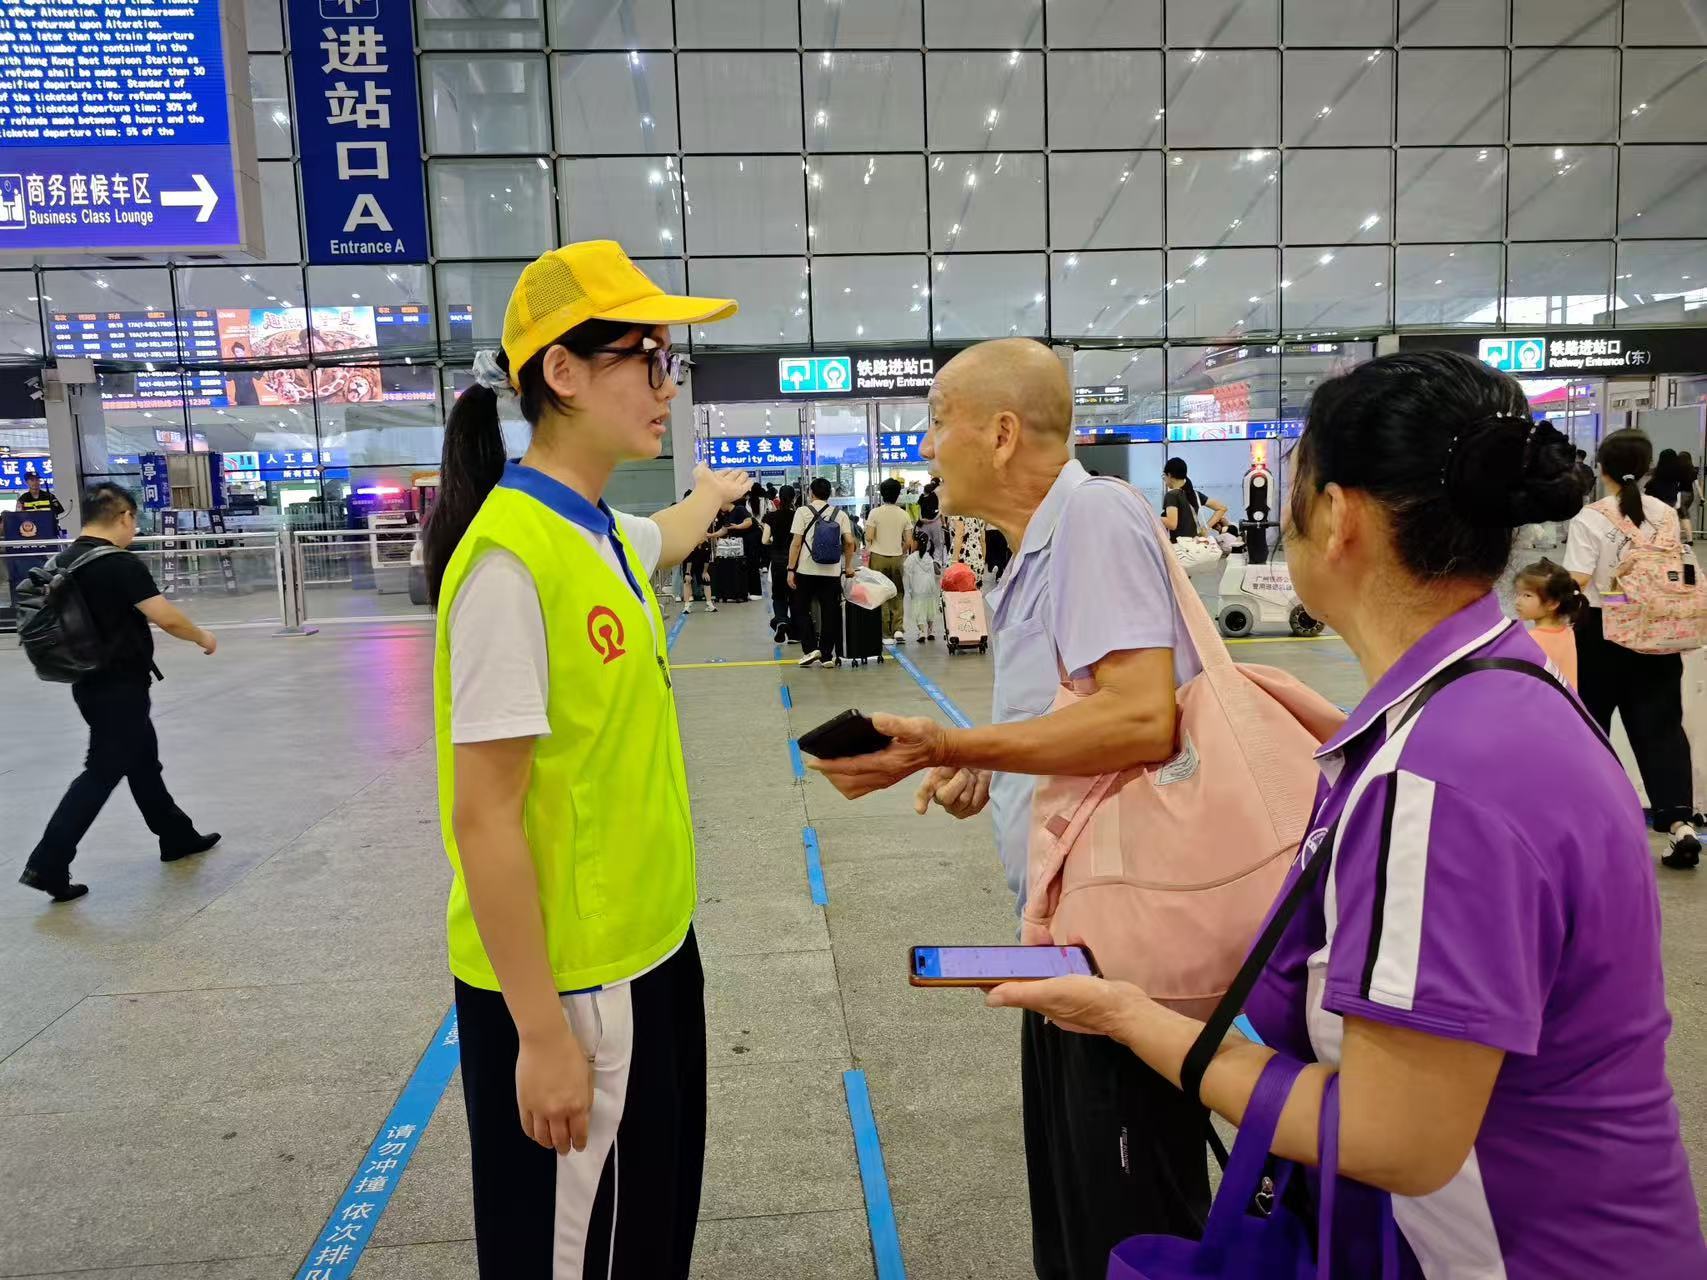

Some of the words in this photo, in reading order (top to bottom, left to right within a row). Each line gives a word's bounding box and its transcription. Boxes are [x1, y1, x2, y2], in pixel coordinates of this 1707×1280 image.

[26, 173, 151, 206] 商务座候车区
[30, 210, 77, 225] Business
[82, 209, 110, 223] Class
[115, 209, 153, 226] Lounge
[330, 240, 391, 254] Entrance
[394, 239, 405, 253] A
[1550, 339, 1620, 356] 铁路进站口
[857, 358, 933, 376] 铁路进站口
[1549, 357, 1585, 368] Railway
[1585, 357, 1624, 366] Entrance
[857, 378, 895, 389] Railway
[721, 456, 762, 464] Security
[767, 454, 794, 462] Check
[355, 1124, 416, 1193] 请勿冲撞
